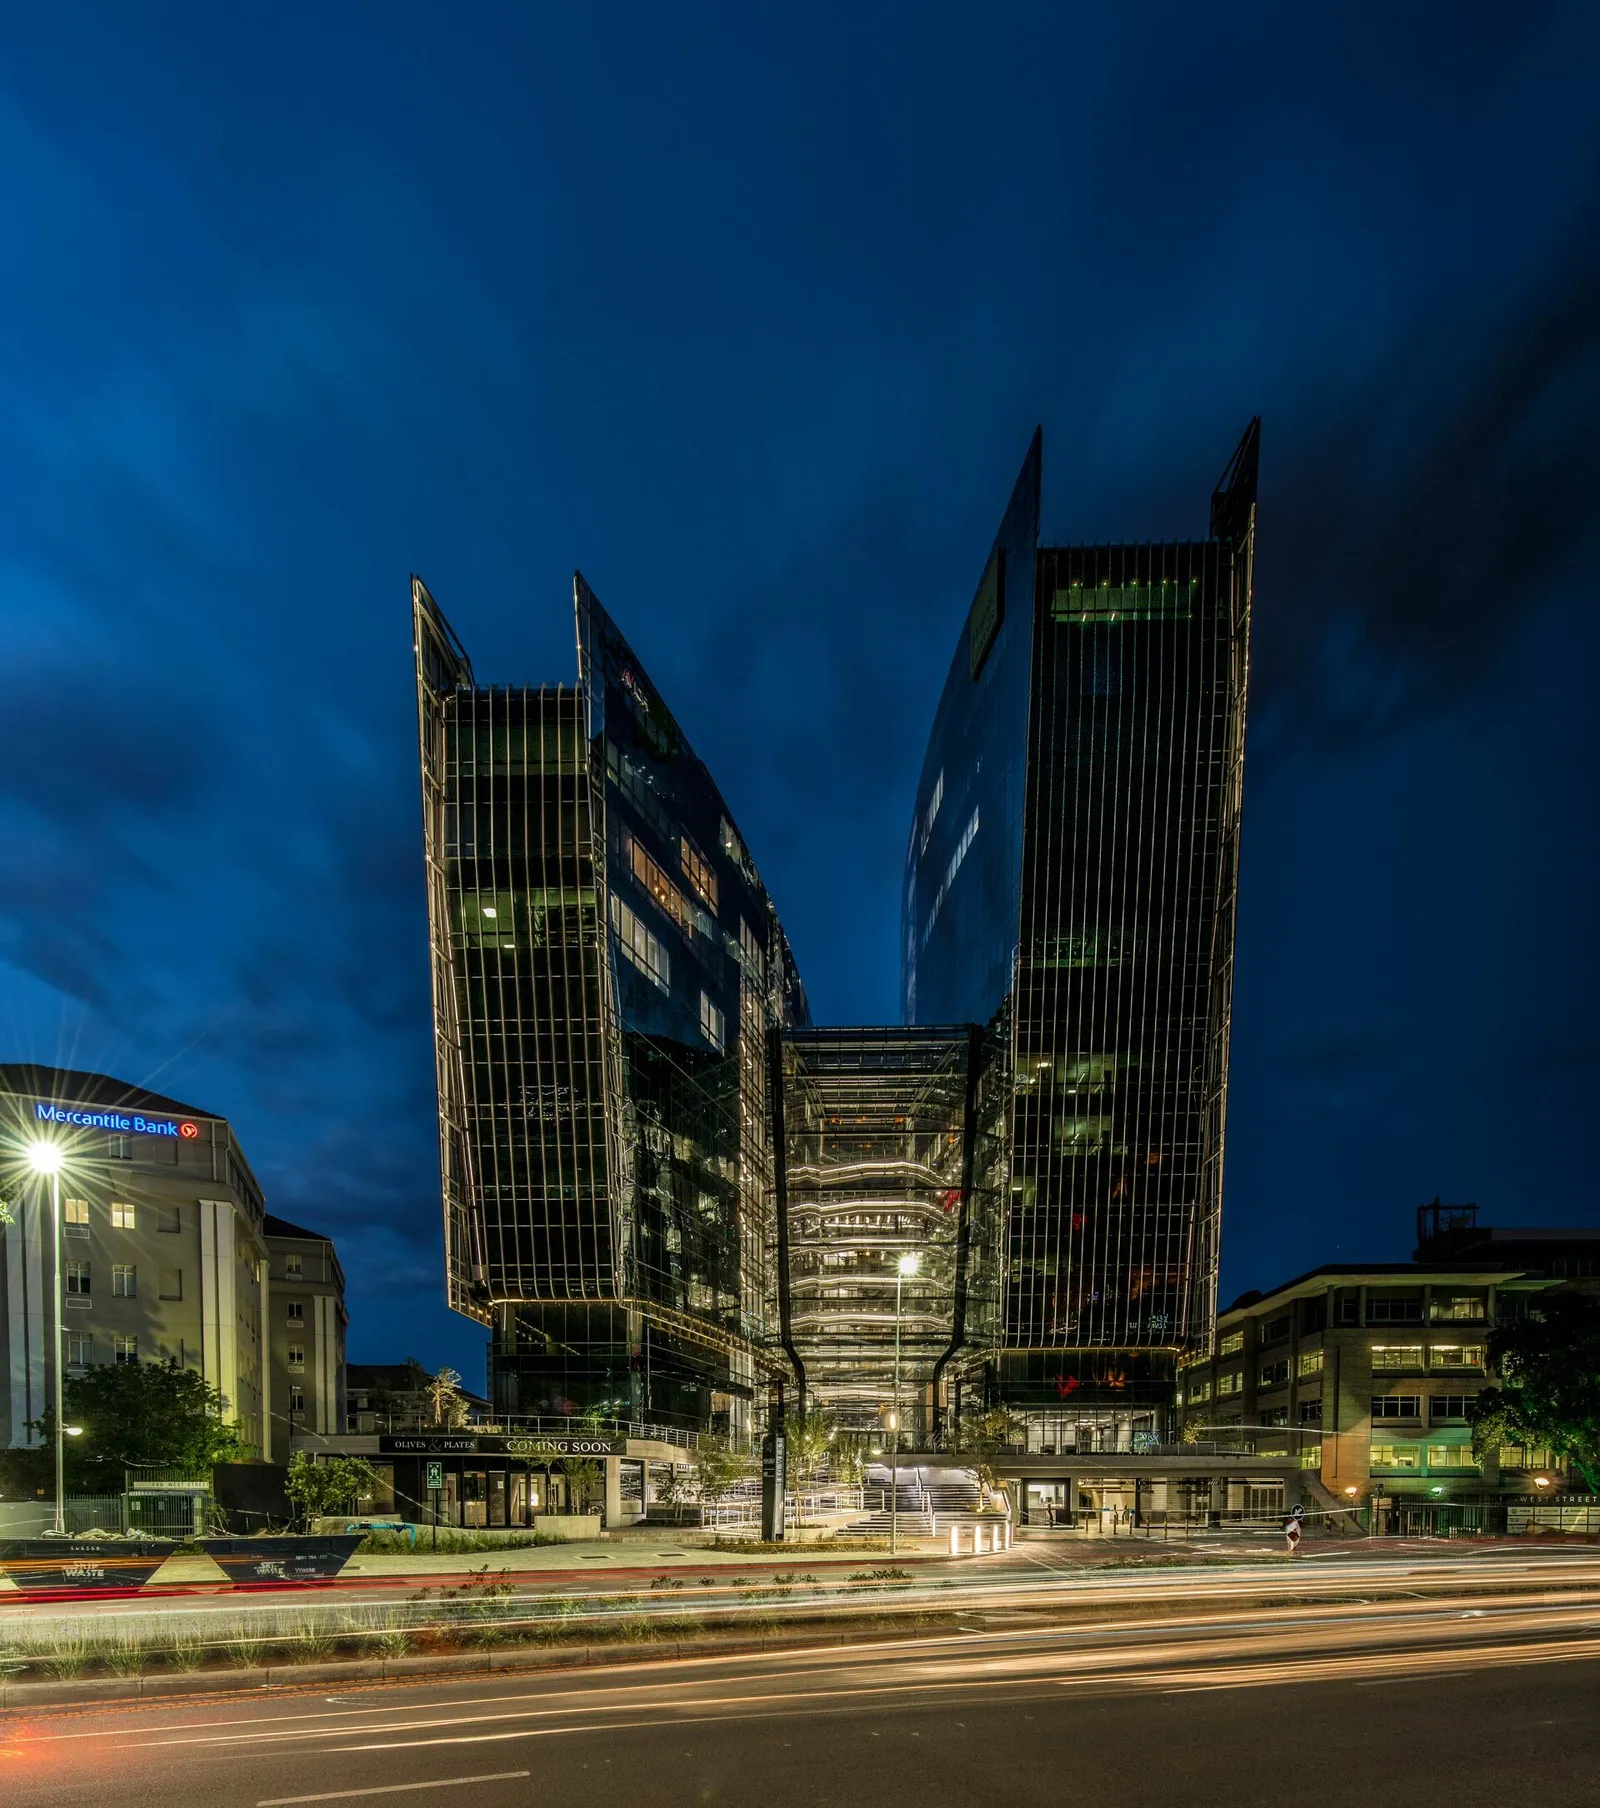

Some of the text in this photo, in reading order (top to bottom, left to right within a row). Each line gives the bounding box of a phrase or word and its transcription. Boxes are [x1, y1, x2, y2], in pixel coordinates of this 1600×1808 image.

[37, 1104, 178, 1136] Mercantile Bank
[507, 1441, 612, 1452] COMING SOON
